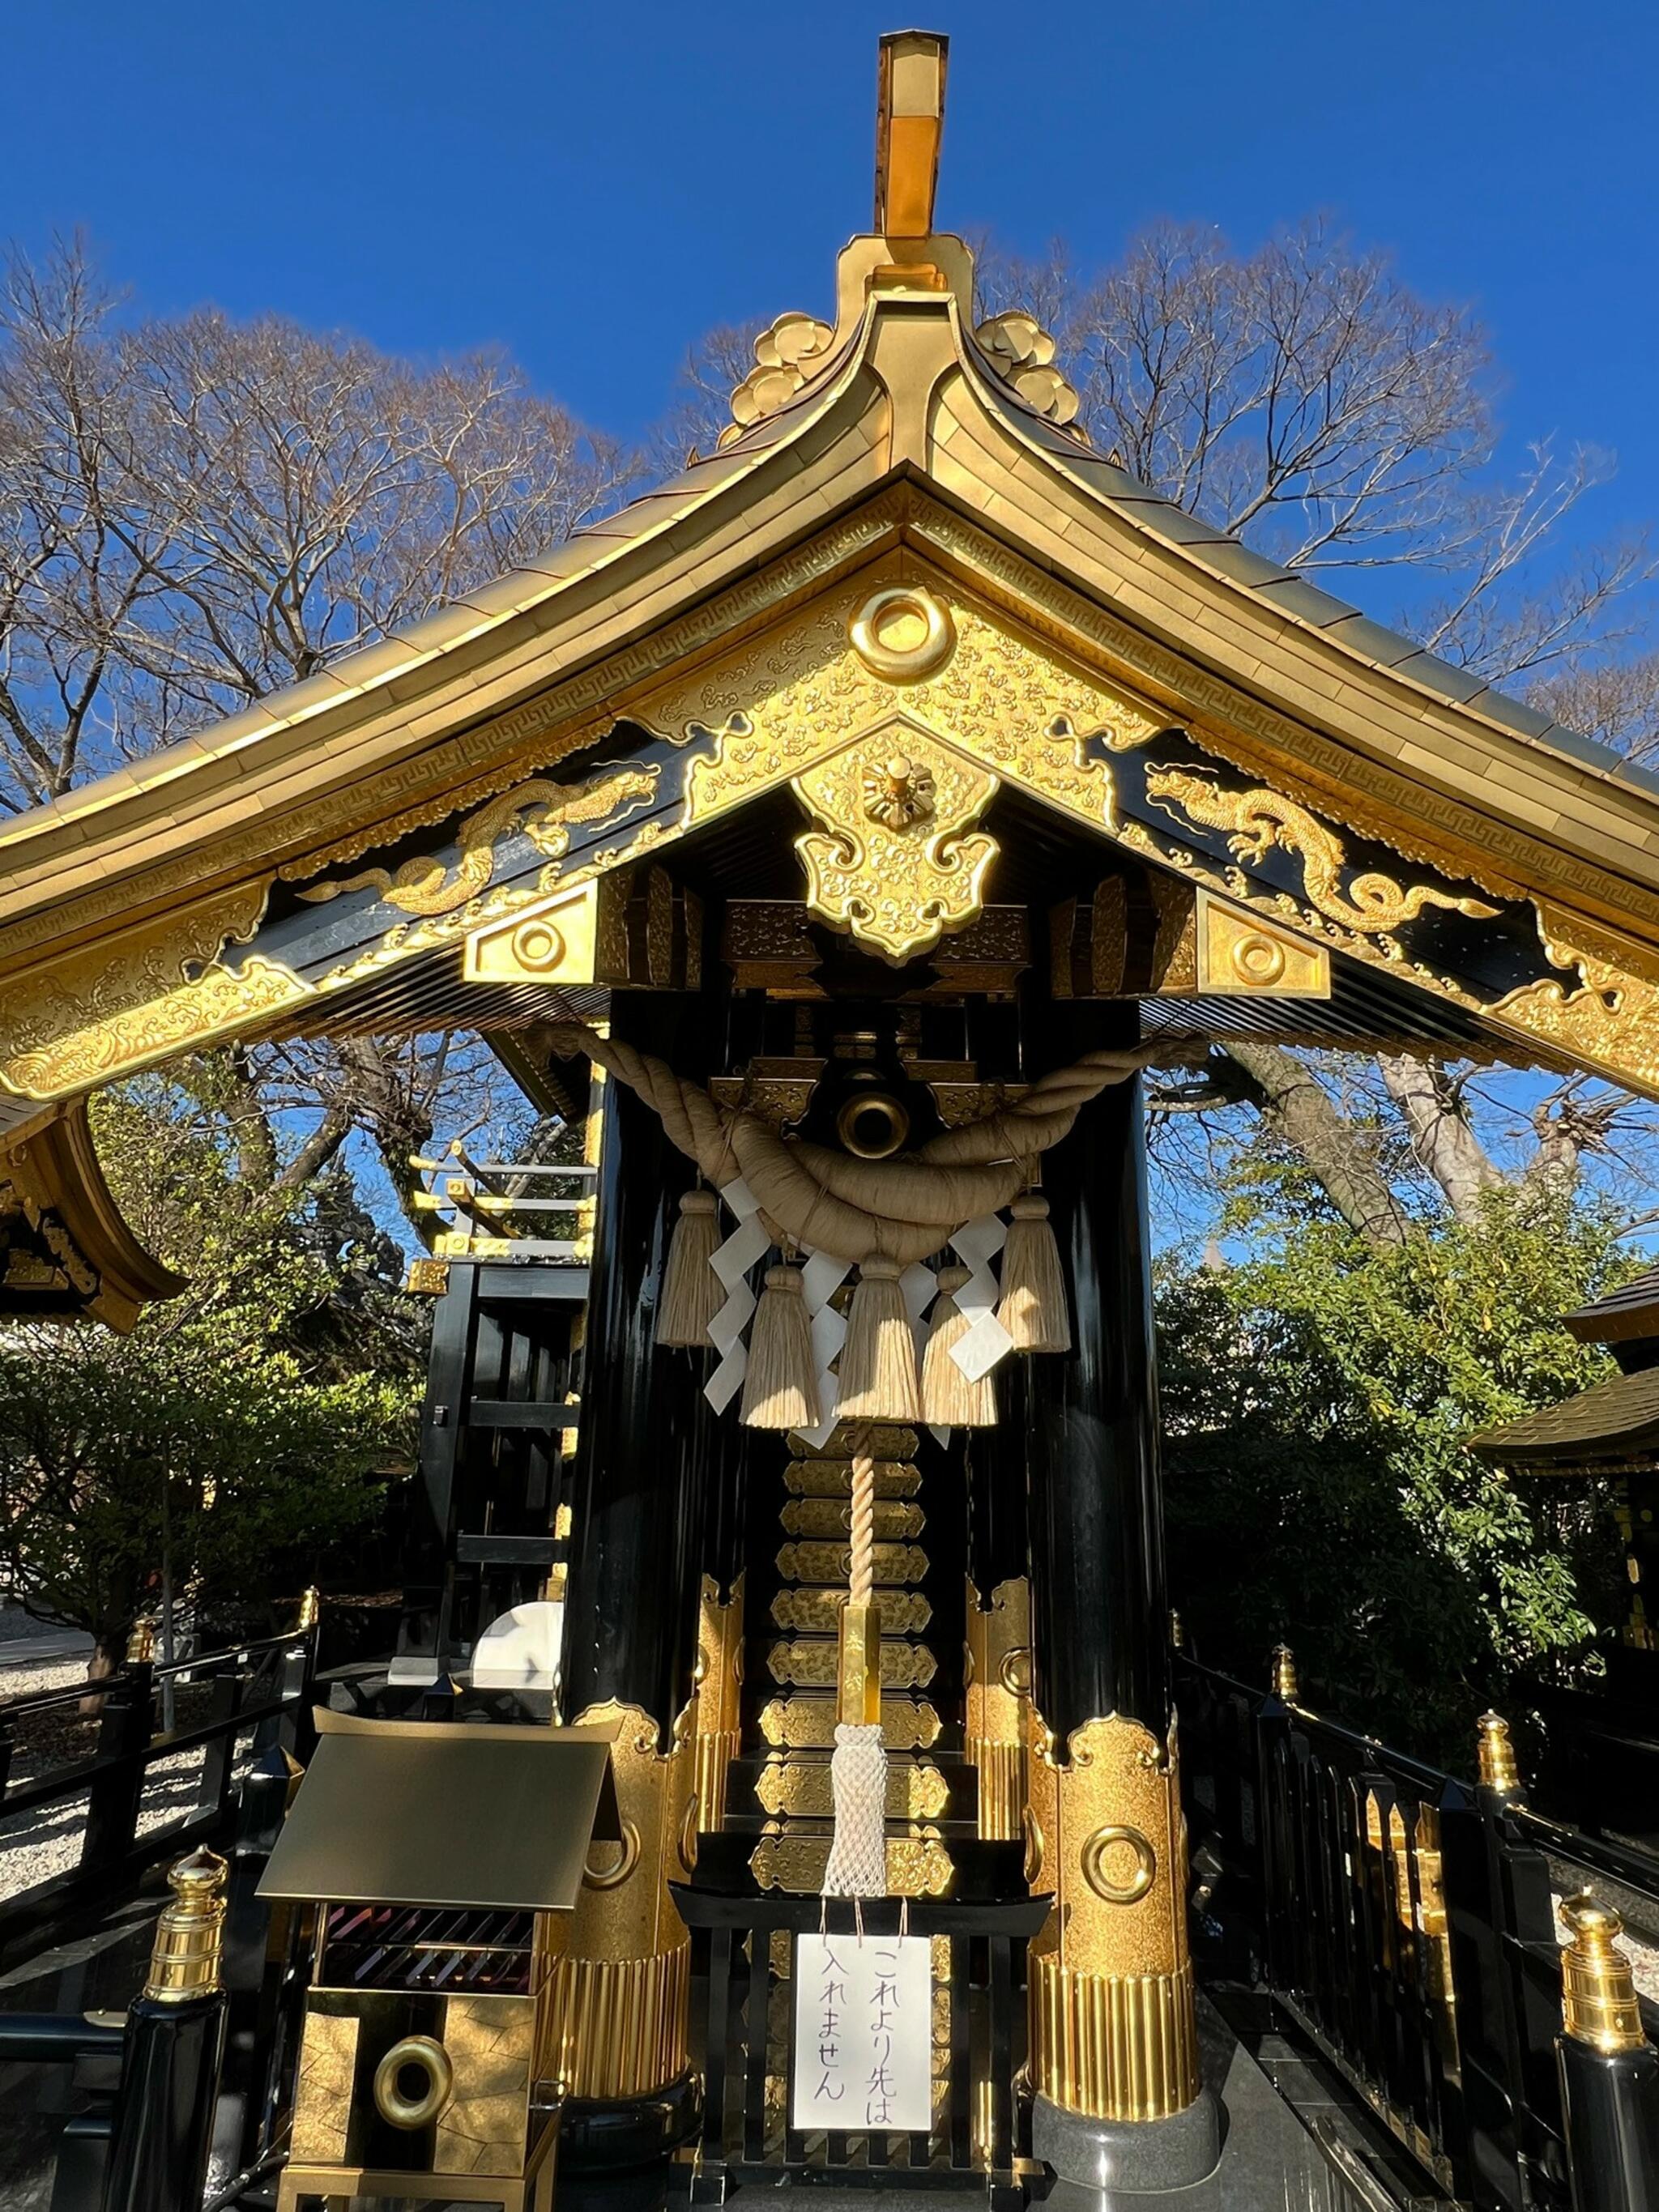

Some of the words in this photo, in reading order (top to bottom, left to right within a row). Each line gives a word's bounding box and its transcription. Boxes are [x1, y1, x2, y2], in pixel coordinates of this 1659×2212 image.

[813, 1949, 850, 2100] 入れません
[865, 1951, 900, 2125] これより先は
